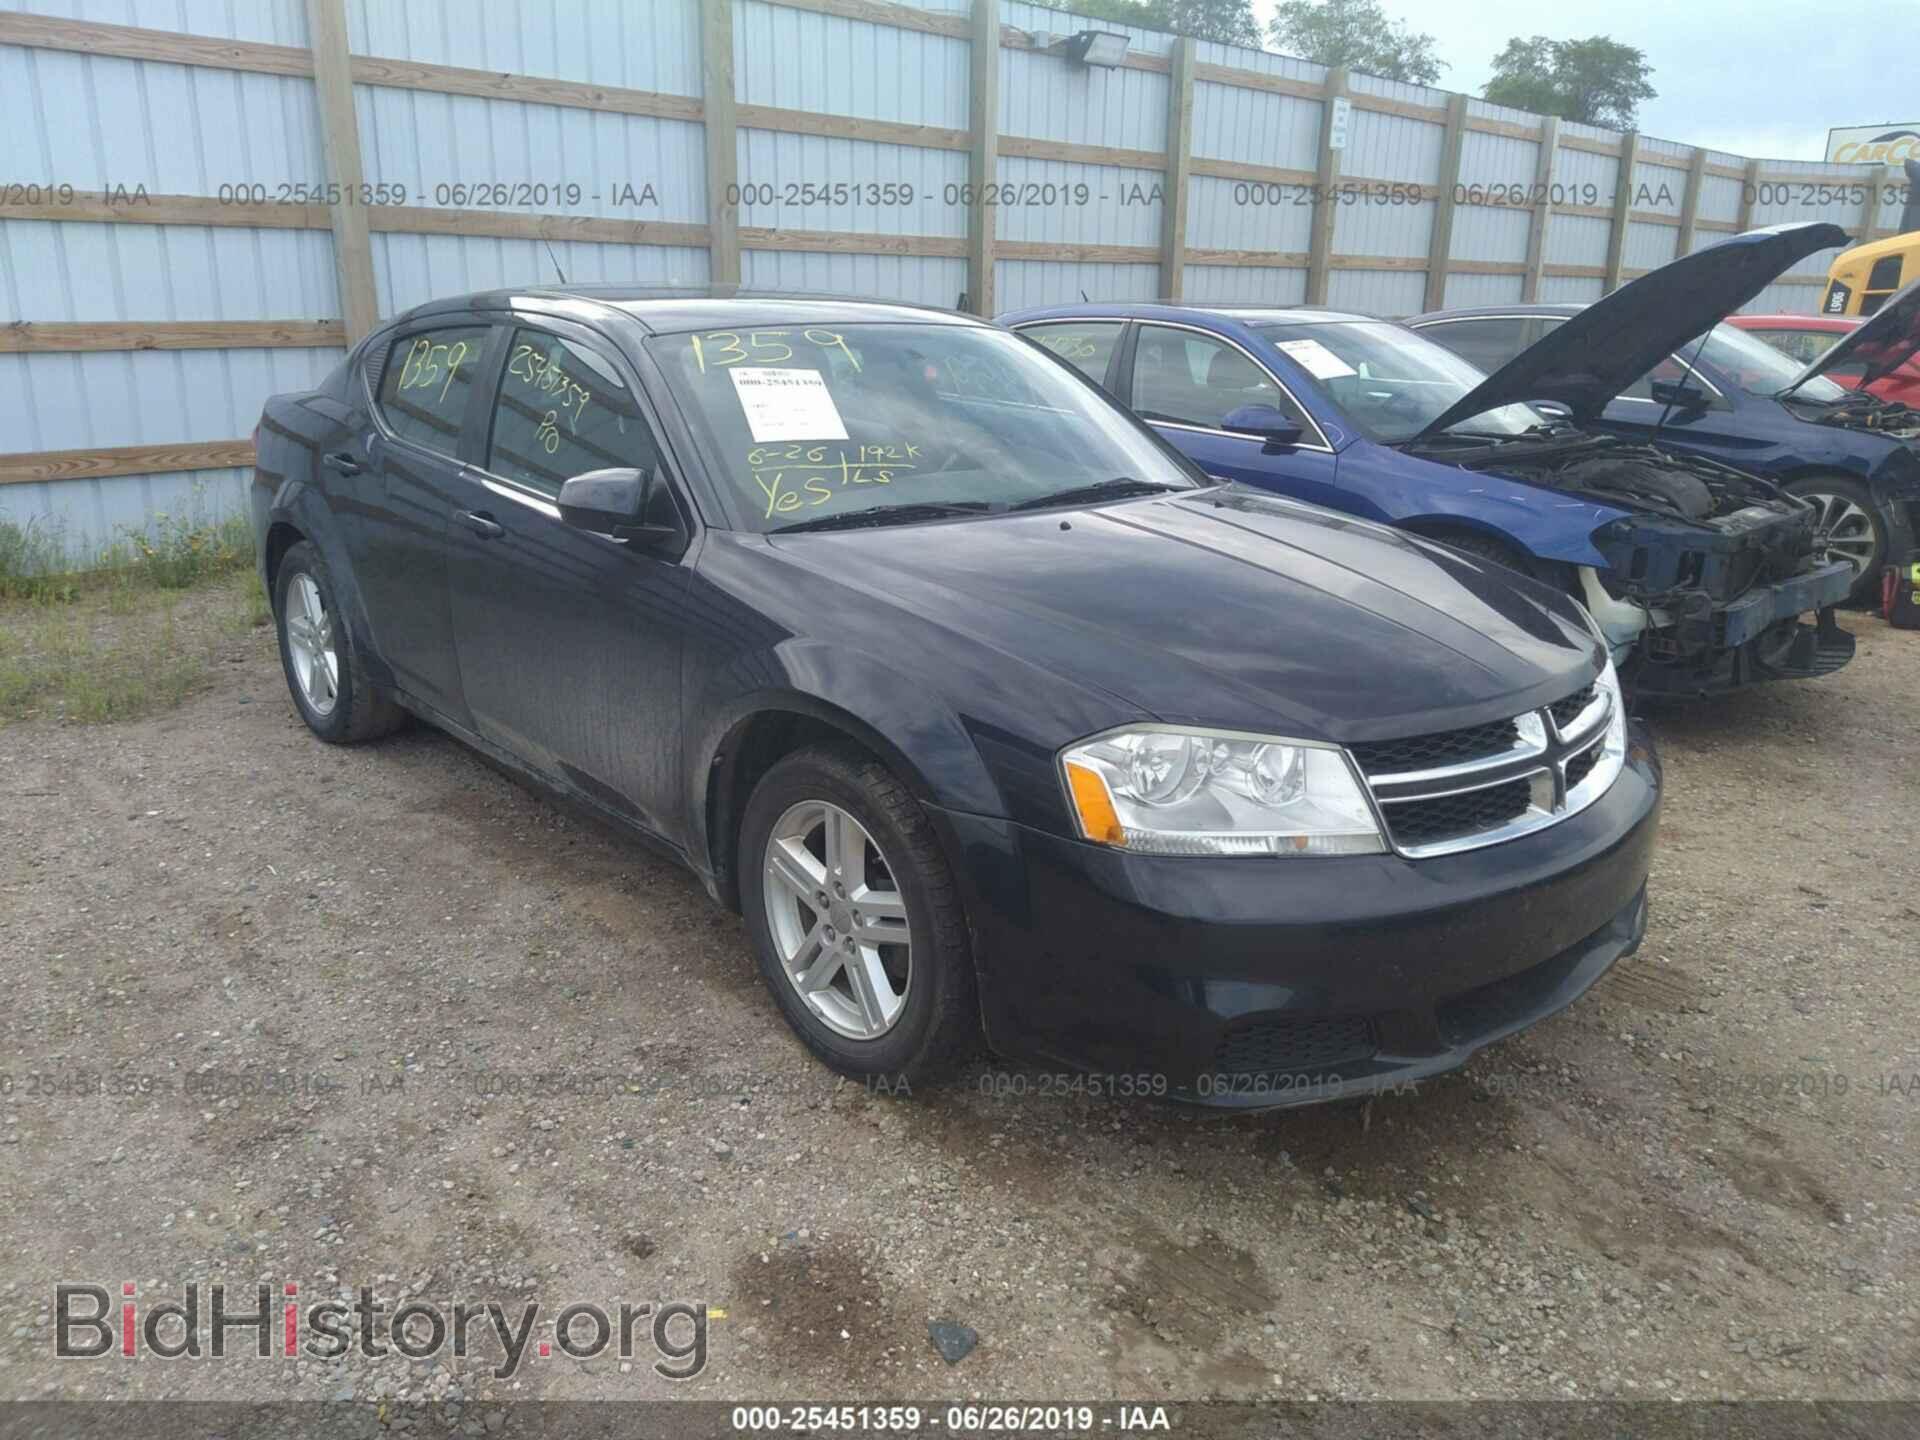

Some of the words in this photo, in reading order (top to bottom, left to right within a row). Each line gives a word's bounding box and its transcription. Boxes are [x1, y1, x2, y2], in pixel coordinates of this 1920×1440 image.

[397, 339, 467, 403] 1359
[692, 329, 862, 375] 1359
[748, 445, 828, 464] 6-26
